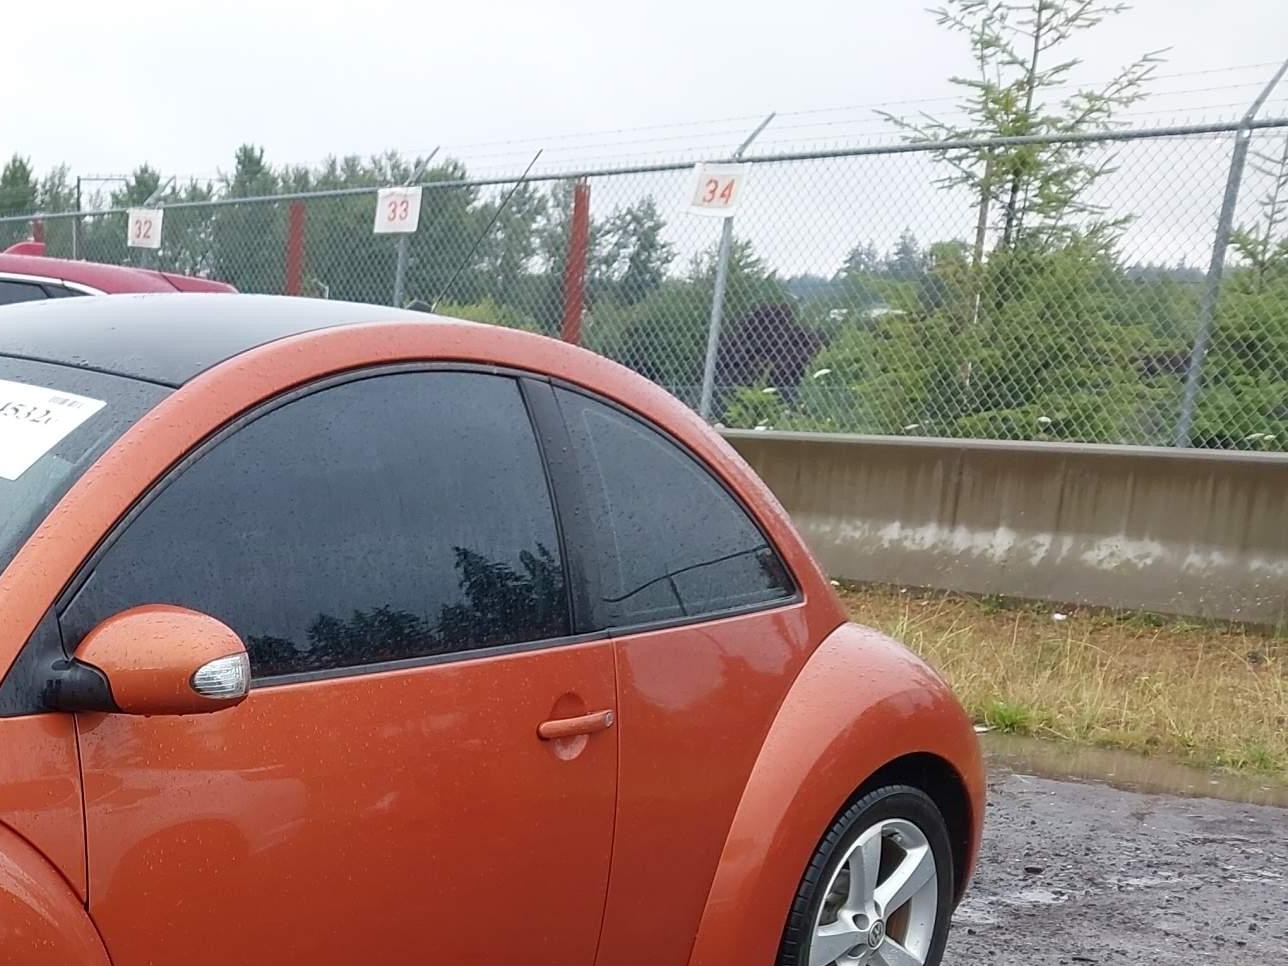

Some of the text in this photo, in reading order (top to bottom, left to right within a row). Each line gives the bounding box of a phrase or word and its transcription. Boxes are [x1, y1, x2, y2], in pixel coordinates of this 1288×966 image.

[703, 178, 735, 204] 34
[387, 200, 409, 221] 33
[135, 219, 152, 239] 32
